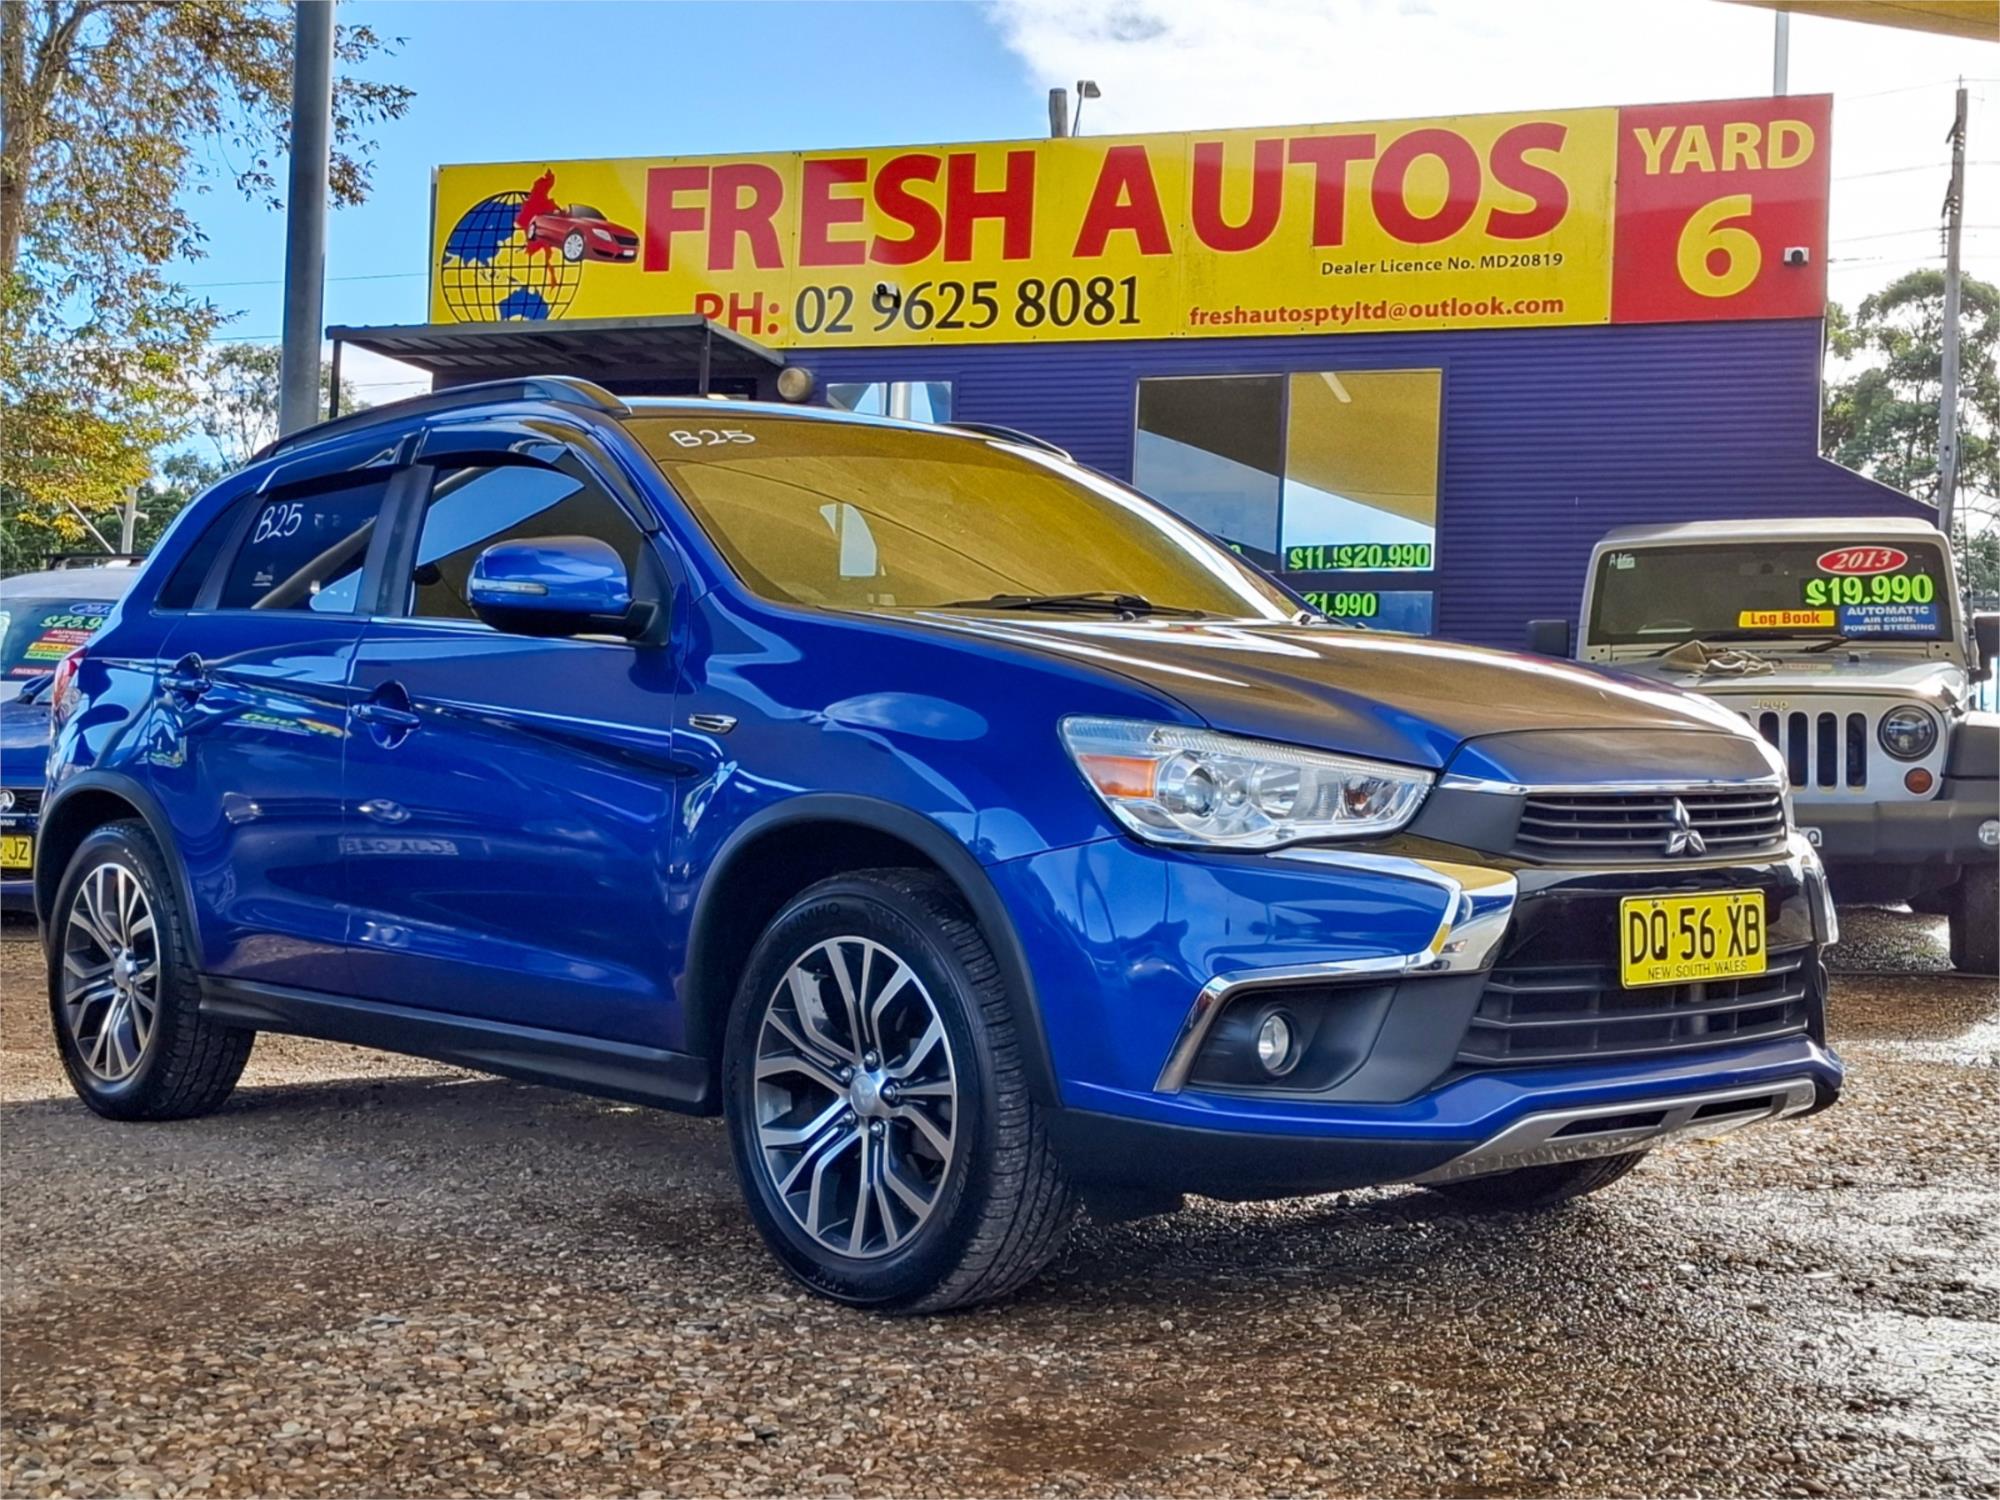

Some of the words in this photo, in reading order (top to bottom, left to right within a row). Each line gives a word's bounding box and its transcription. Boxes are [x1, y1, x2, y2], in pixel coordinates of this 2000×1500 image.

[1633, 120, 1815, 175] YARD
[643, 150, 1036, 273] FRESH
[1073, 121, 1570, 258] AUTOS
[1676, 194, 1762, 298] 6
[1321, 261, 1376, 275] Dealer
[1380, 258, 1443, 273] Licence
[1447, 257, 1475, 270] No.
[1480, 253, 1563, 269] MD20819
[694, 291, 780, 336] PH:
[795, 285, 854, 334] 02
[871, 279, 999, 332] 9625
[1014, 274, 1141, 328] 8081
[1189, 296, 1564, 327] freshautosptyltd@outlook.com
[668, 429, 756, 447] B25
[253, 503, 304, 544] B25
[1288, 546, 1338, 570] $11.
[1338, 544, 1431, 569] $20.990
[1832, 550, 1893, 570] 2013
[1805, 574, 1934, 606] $19.990
[1751, 613, 1778, 626] Log
[1781, 611, 1821, 625] Book
[1846, 606, 1930, 616] AUTOMATIC
[1863, 616, 1882, 624] AIR
[1884, 616, 1916, 624] COND.
[1843, 624, 1881, 632] POWER
[1882, 623, 1936, 632] STEERING
[1751, 699, 1789, 712] Jeep
[1629, 909, 1669, 965] DQ
[1679, 907, 1716, 960] 56
[1726, 904, 1761, 957] XB
[1647, 965, 1672, 981] NEW
[1675, 962, 1711, 977] SOUTH
[1714, 959, 1748, 973] WALES
